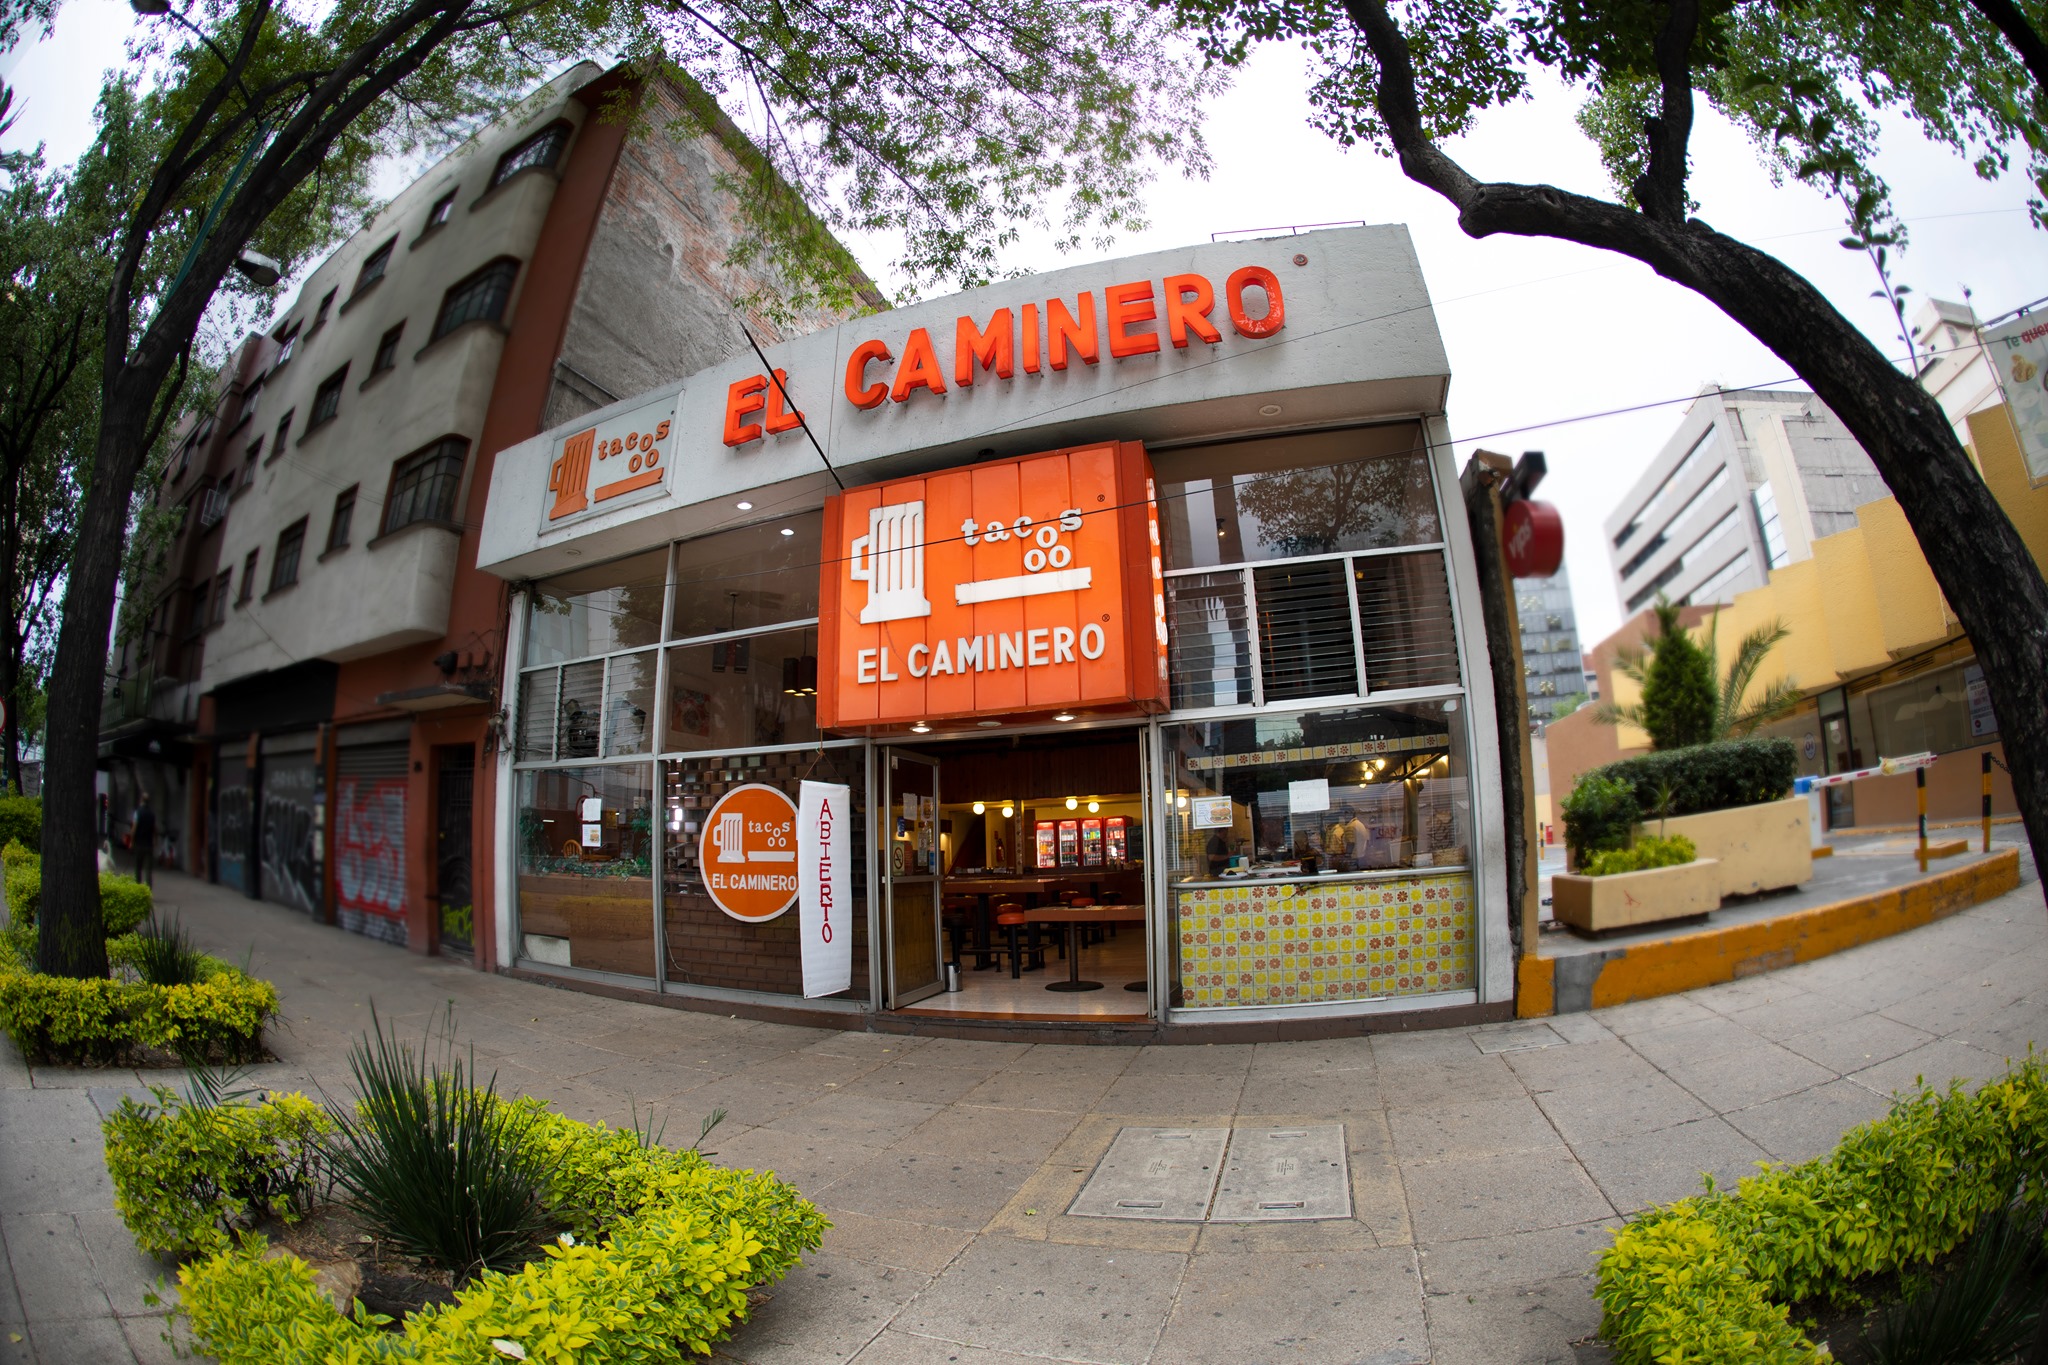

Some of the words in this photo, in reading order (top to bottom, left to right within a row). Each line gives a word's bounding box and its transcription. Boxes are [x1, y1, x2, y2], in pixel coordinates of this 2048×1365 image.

[723, 368, 805, 447] EL
[844, 265, 1286, 409] CAMINERO
[857, 646, 898, 684] EL
[907, 622, 1105, 677] CAMINERO
[712, 874, 727, 889] EL
[730, 874, 797, 891] CAMINERO
[819, 798, 834, 944] ABIERTO
